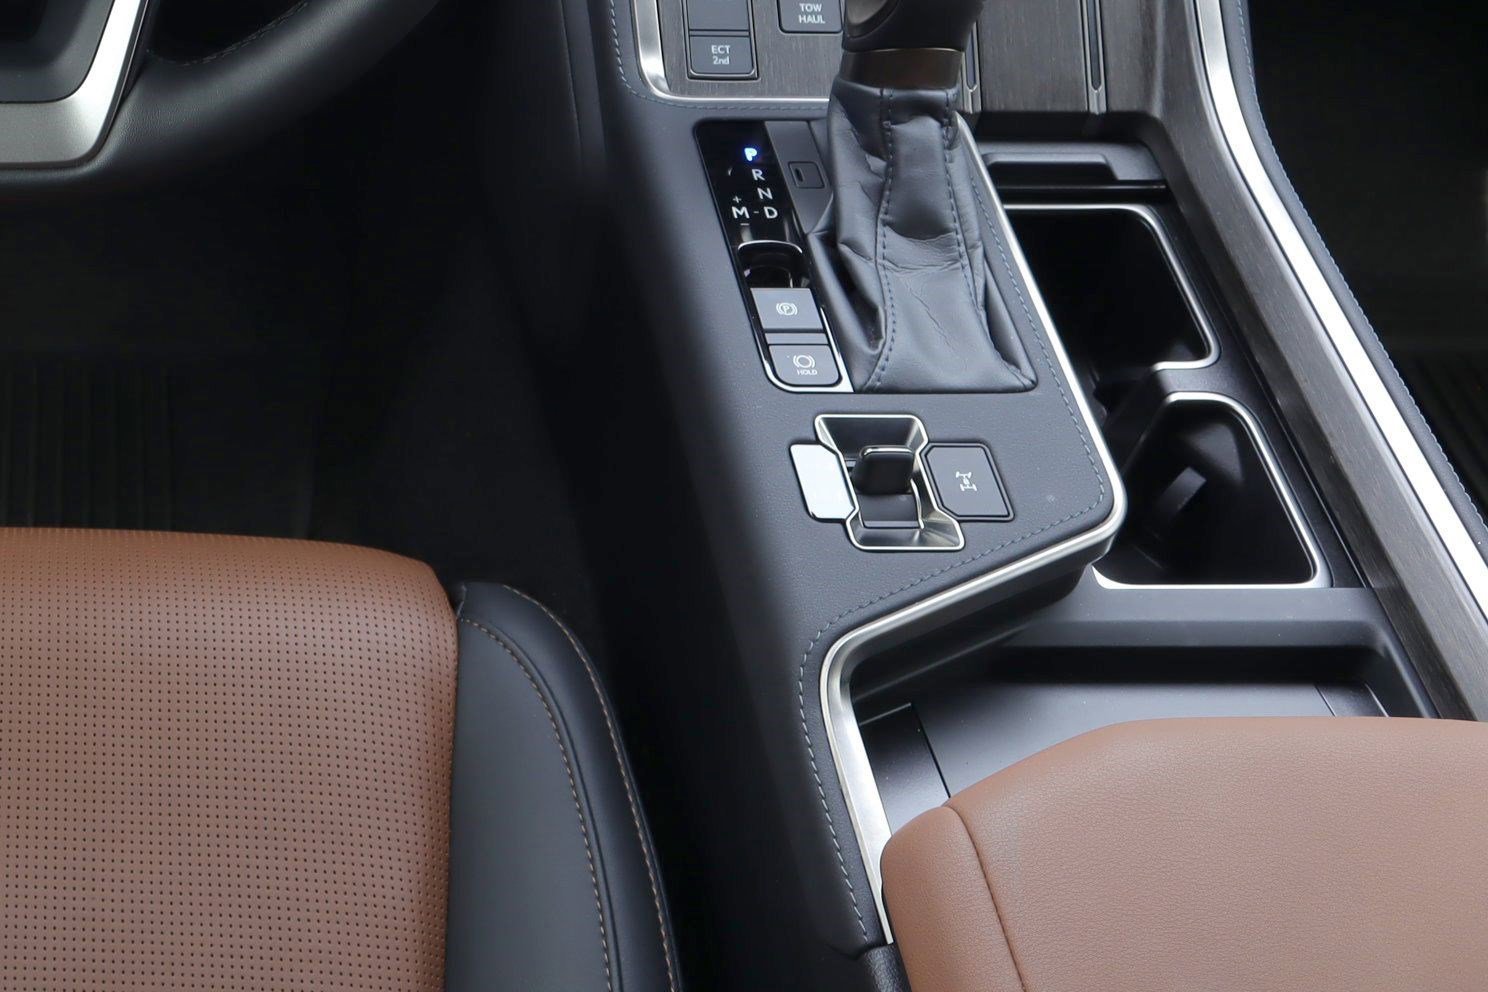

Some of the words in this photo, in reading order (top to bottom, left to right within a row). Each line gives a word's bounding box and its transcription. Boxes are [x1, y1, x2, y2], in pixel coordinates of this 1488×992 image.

[799, 2, 822, 13] TOW
[798, 14, 826, 24] HAUL
[711, 44, 731, 55] ECT
[712, 55, 730, 65] 2nd
[743, 147, 758, 162] P
[751, 168, 766, 181] R
[756, 187, 773, 200] N
[731, 206, 750, 219] M
[763, 206, 778, 219] D
